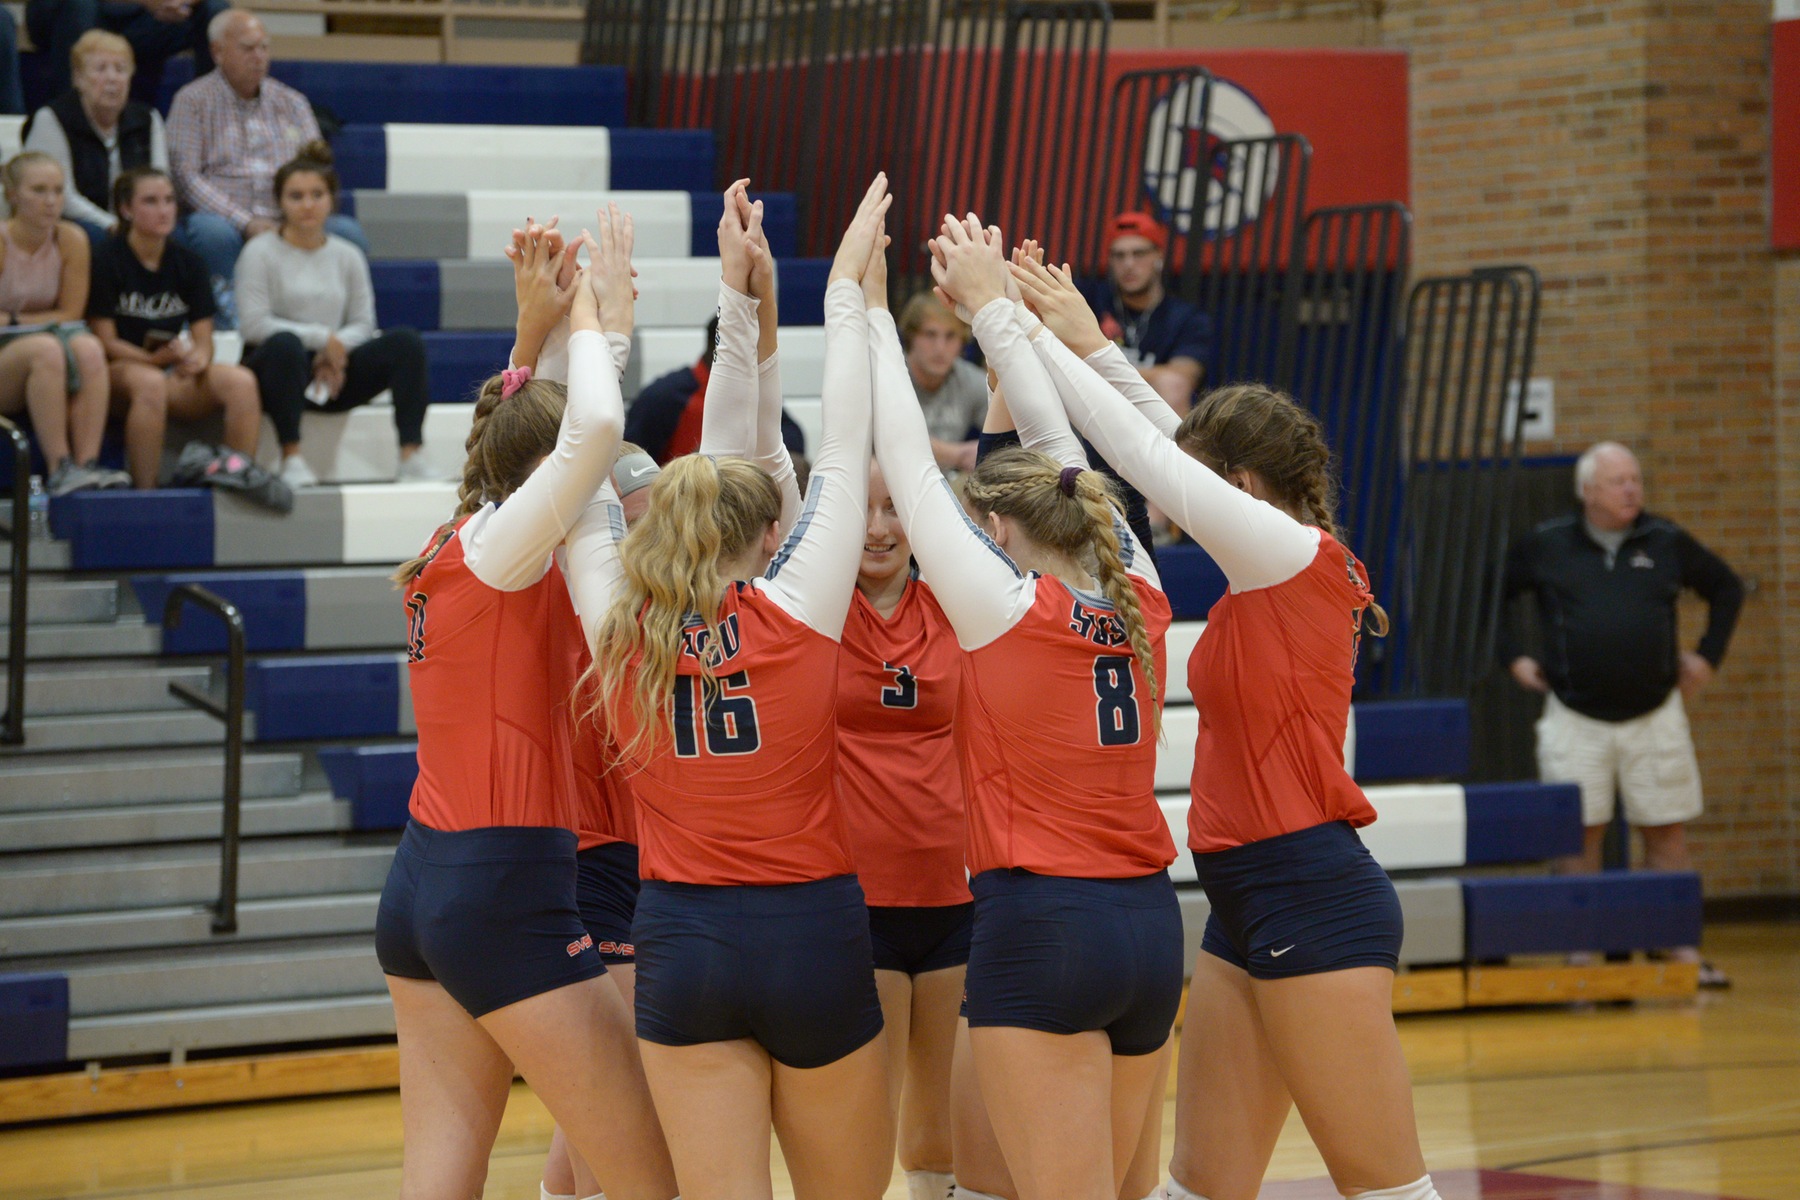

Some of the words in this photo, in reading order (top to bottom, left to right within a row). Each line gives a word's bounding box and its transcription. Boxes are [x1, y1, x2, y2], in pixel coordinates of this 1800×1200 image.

[673, 670, 761, 757] 16
[881, 662, 918, 708] 3
[1094, 656, 1141, 745] 8
